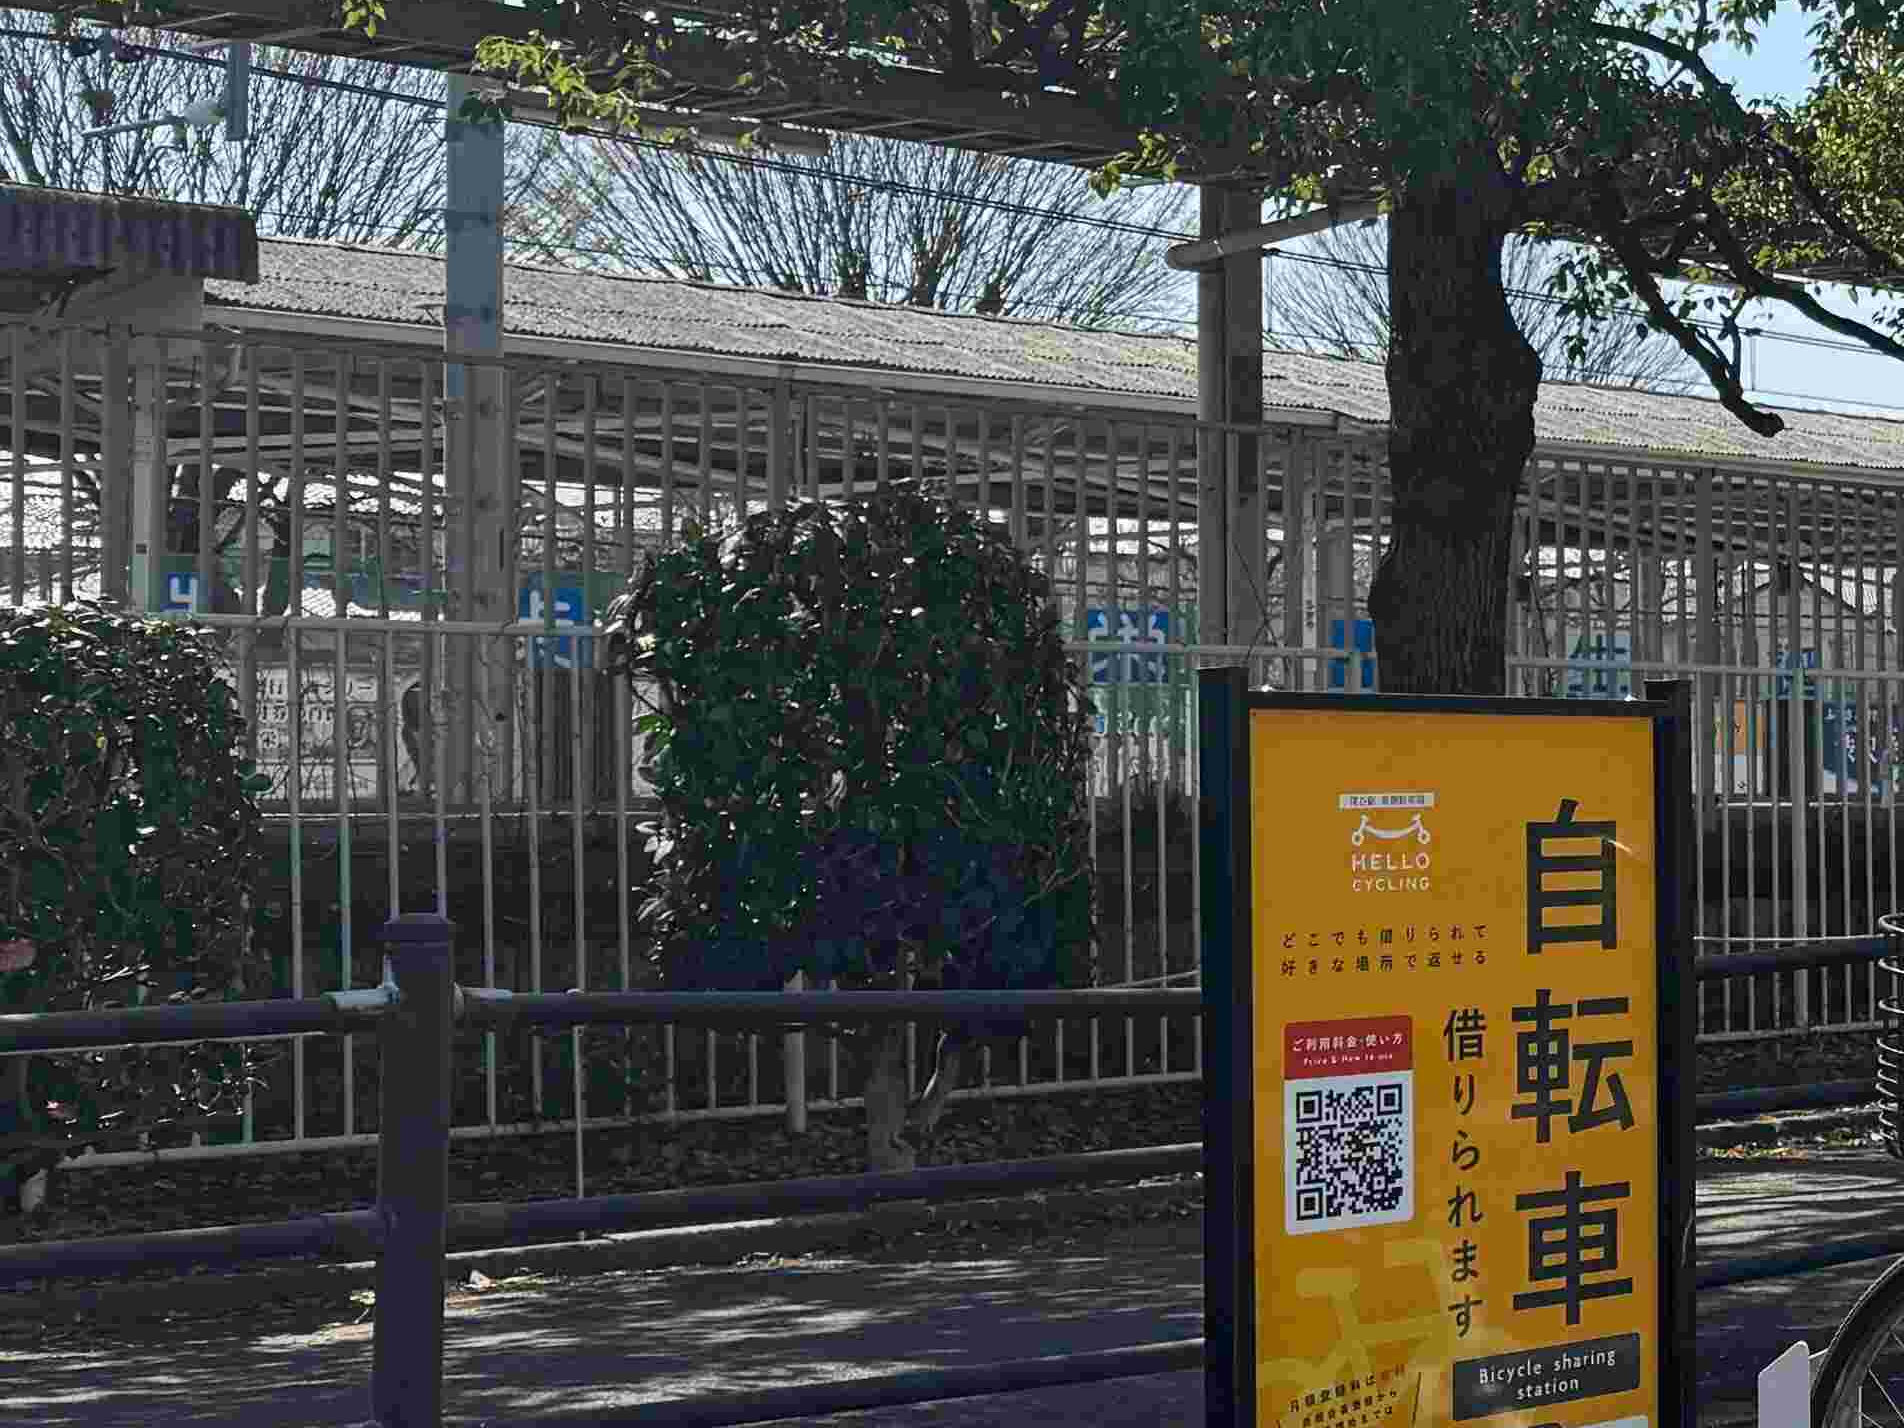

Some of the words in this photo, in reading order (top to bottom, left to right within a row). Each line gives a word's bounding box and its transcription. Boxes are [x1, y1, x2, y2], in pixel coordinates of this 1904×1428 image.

[1351, 852, 1430, 871] HELLO
[1351, 875, 1431, 892] CYCLING
[1280, 925, 1489, 949] どこでも借りられて
[1280, 951, 1488, 978] 好きな場所で返せる
[1512, 798, 1635, 1325] 自転車
[1443, 1007, 1488, 1339] 借りられます
[1479, 1359, 1543, 1385] Bicycle
[1554, 1349, 1616, 1372] sharing
[1516, 1377, 1580, 1401] station
